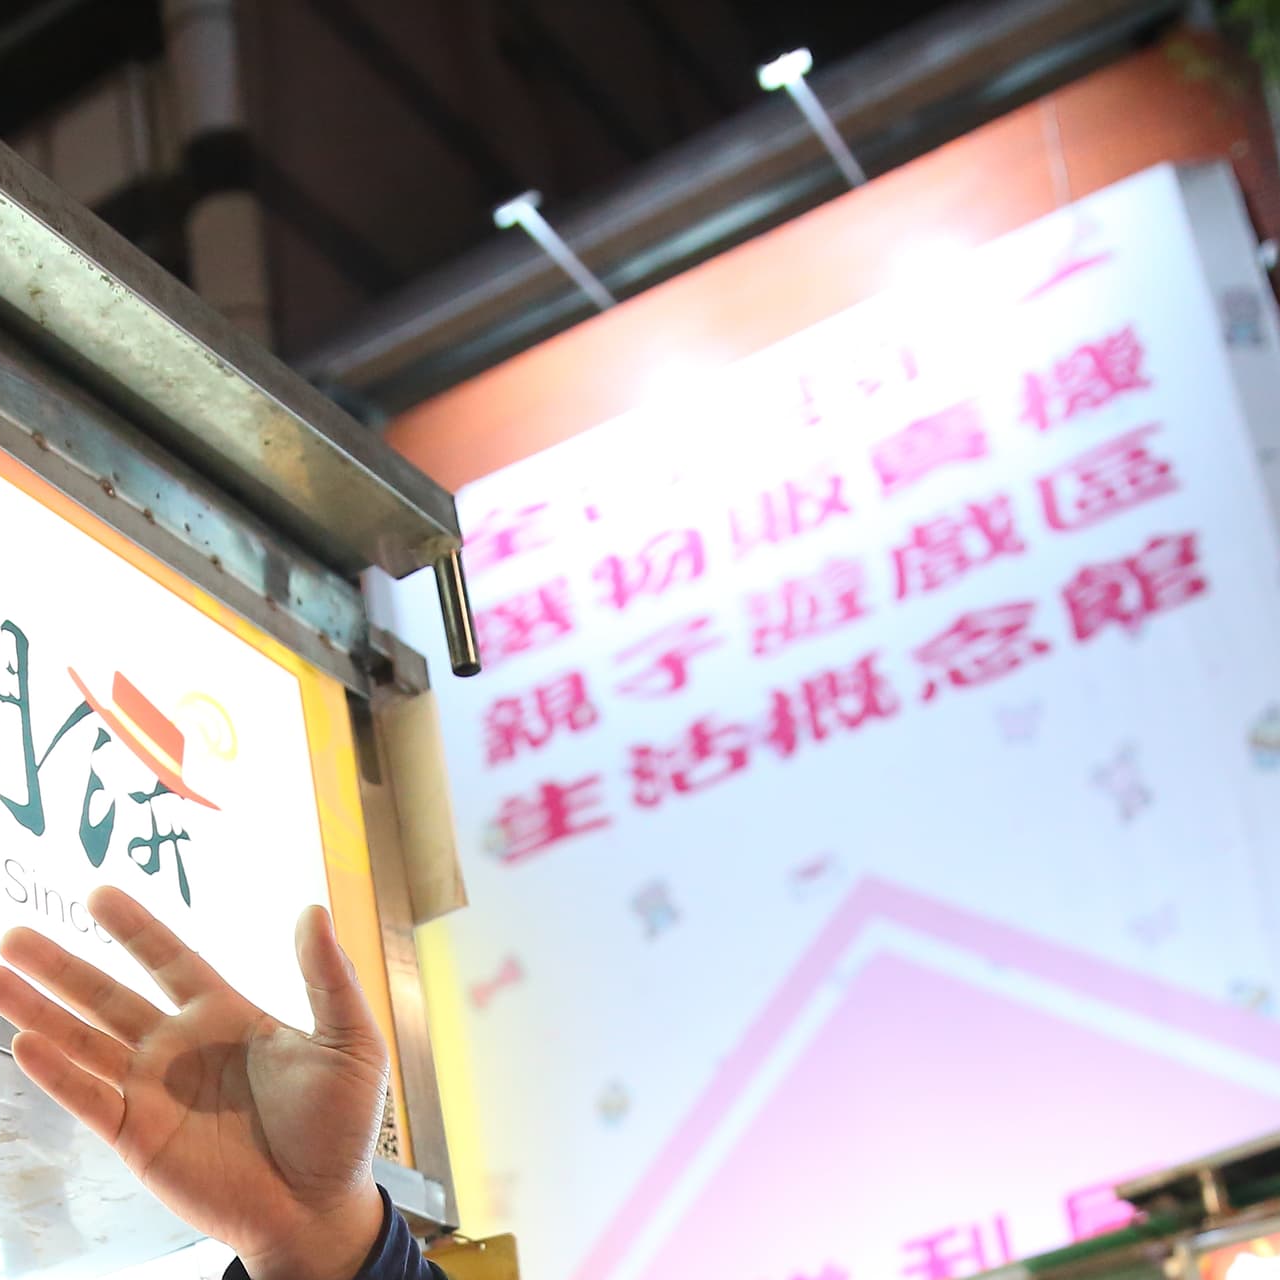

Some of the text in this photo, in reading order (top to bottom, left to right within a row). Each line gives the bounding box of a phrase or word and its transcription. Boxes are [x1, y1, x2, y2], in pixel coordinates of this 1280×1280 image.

[481, 422, 1182, 770] 親子遊戲區
[490, 529, 1212, 866] 生活概念館
